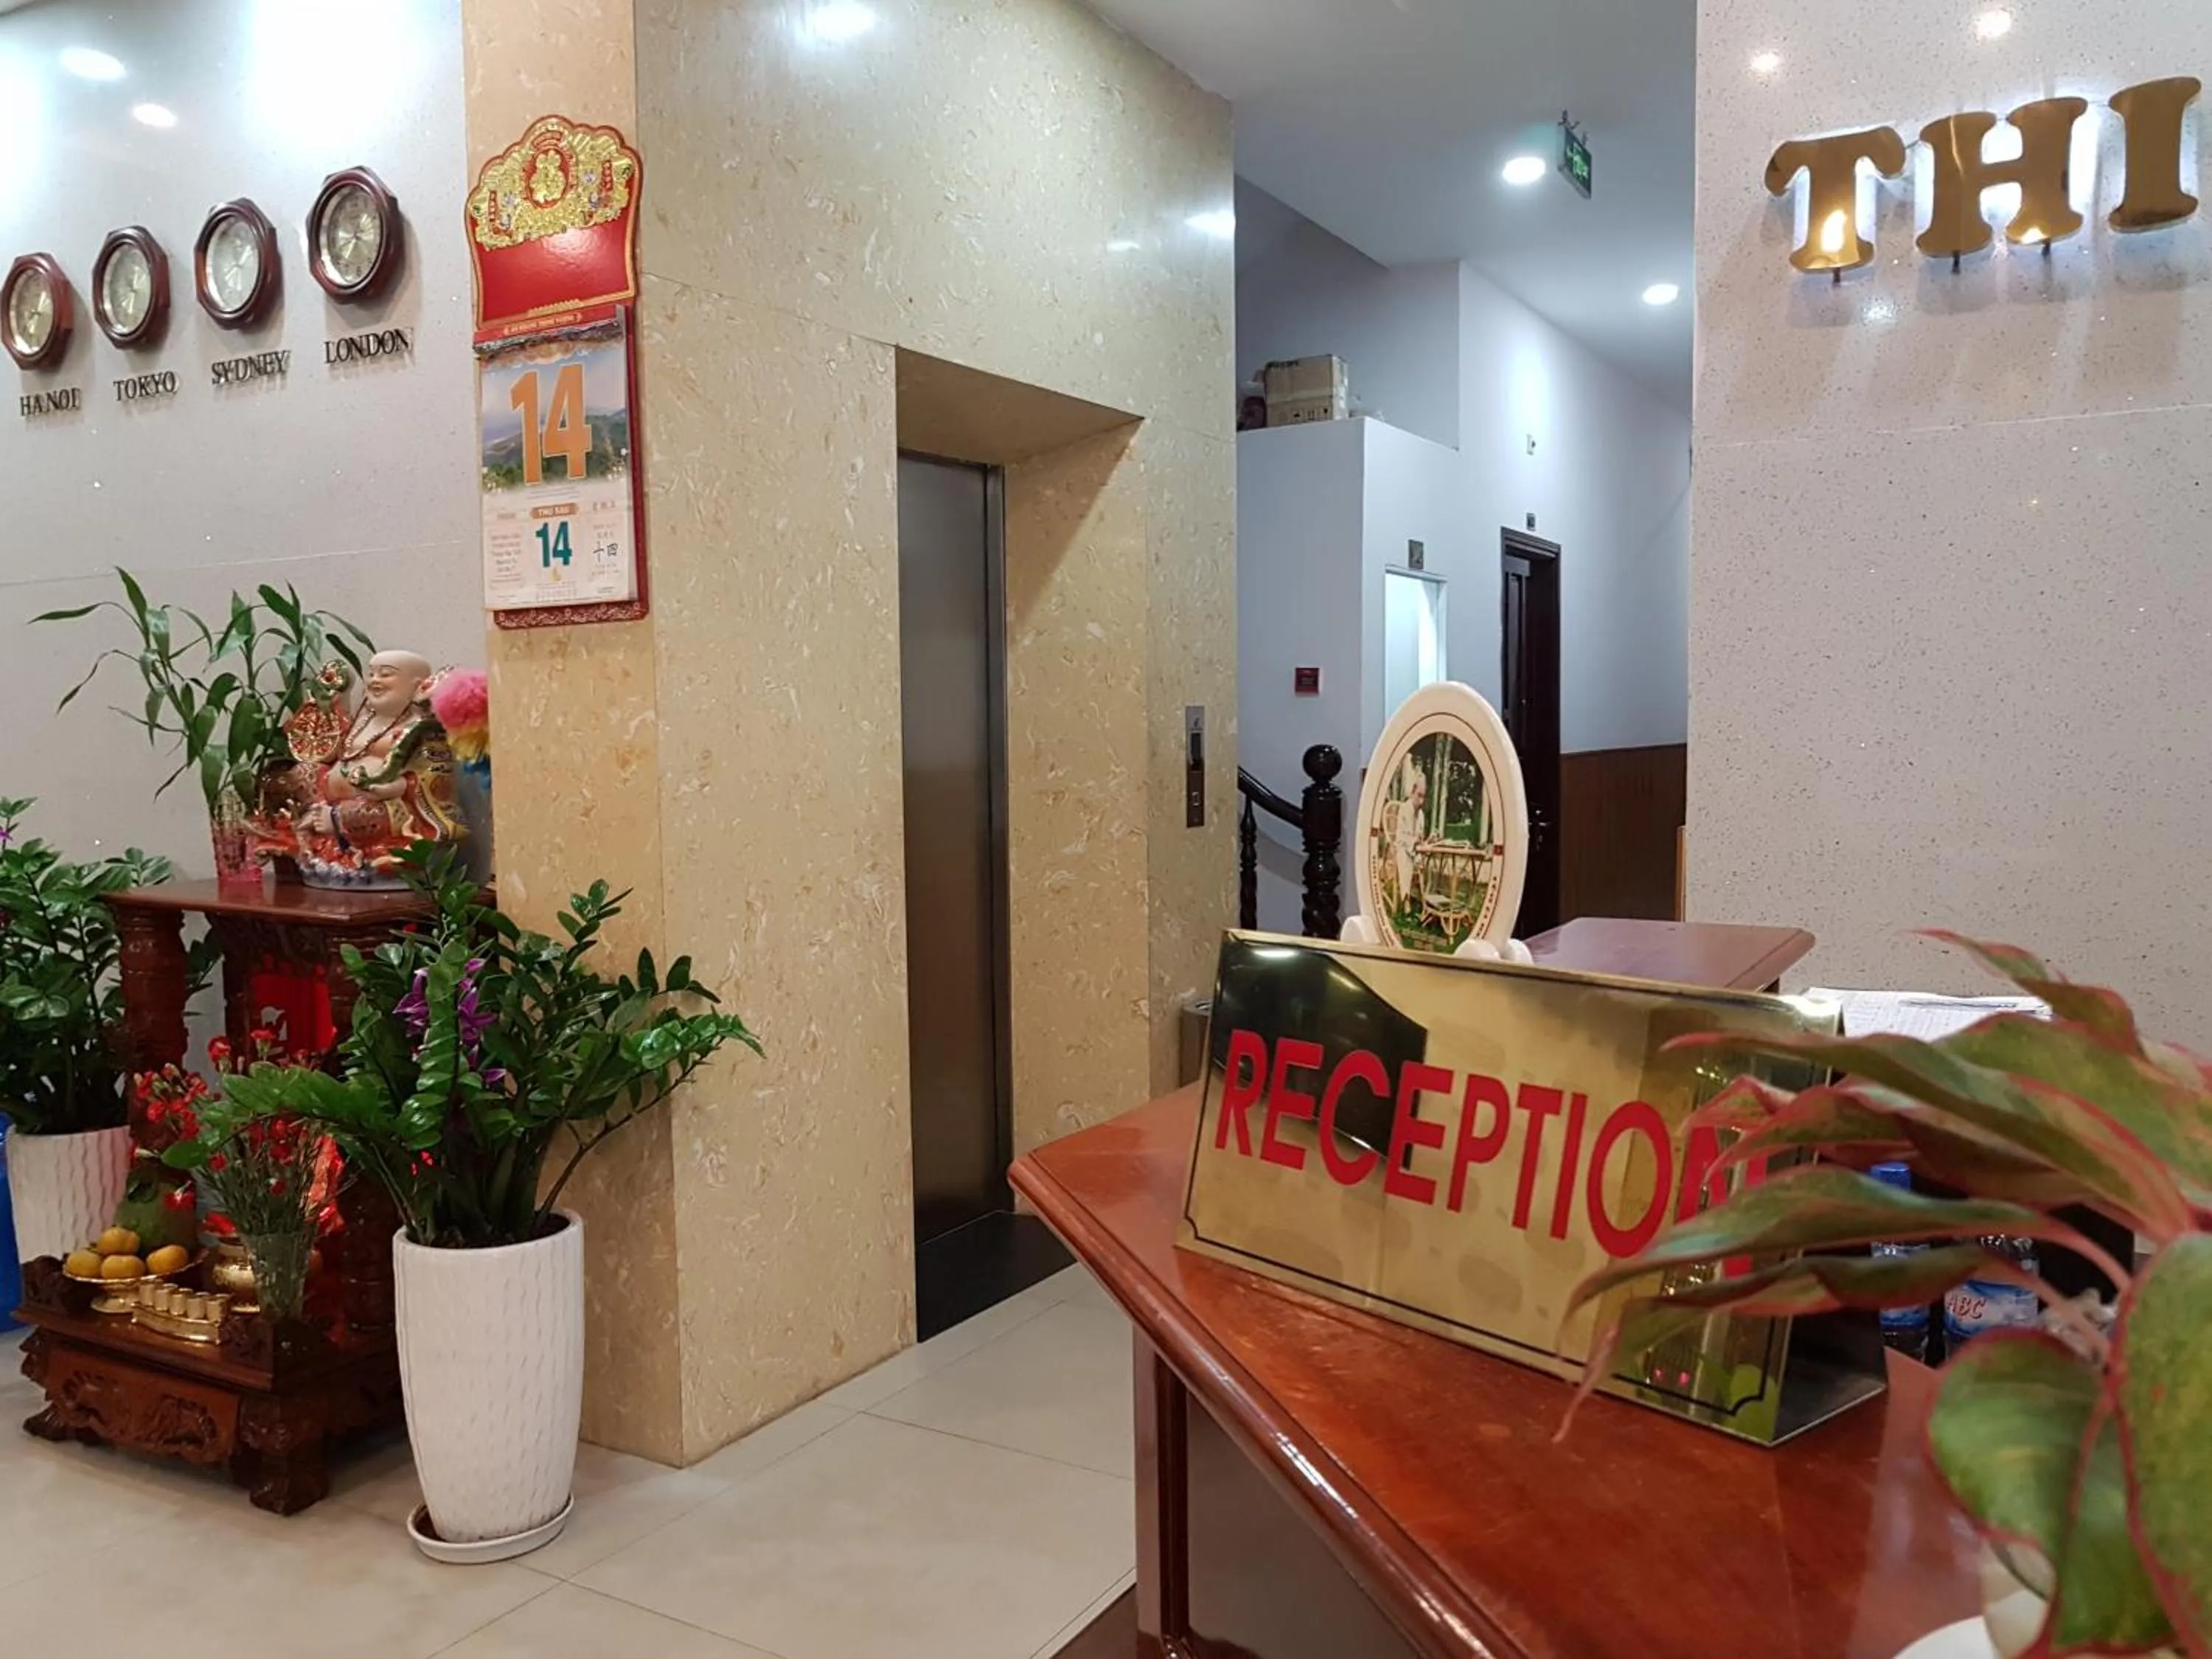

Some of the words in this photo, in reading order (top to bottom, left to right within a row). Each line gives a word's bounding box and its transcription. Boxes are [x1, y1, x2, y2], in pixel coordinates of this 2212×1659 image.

[1765, 77, 2202, 273] THI
[324, 328, 413, 364] LONDON
[212, 350, 291, 384] SYDNEY
[19, 388, 81, 416] HANOI
[113, 371, 178, 401] TOKYO
[509, 362, 591, 485] 14
[535, 520, 572, 568] 14
